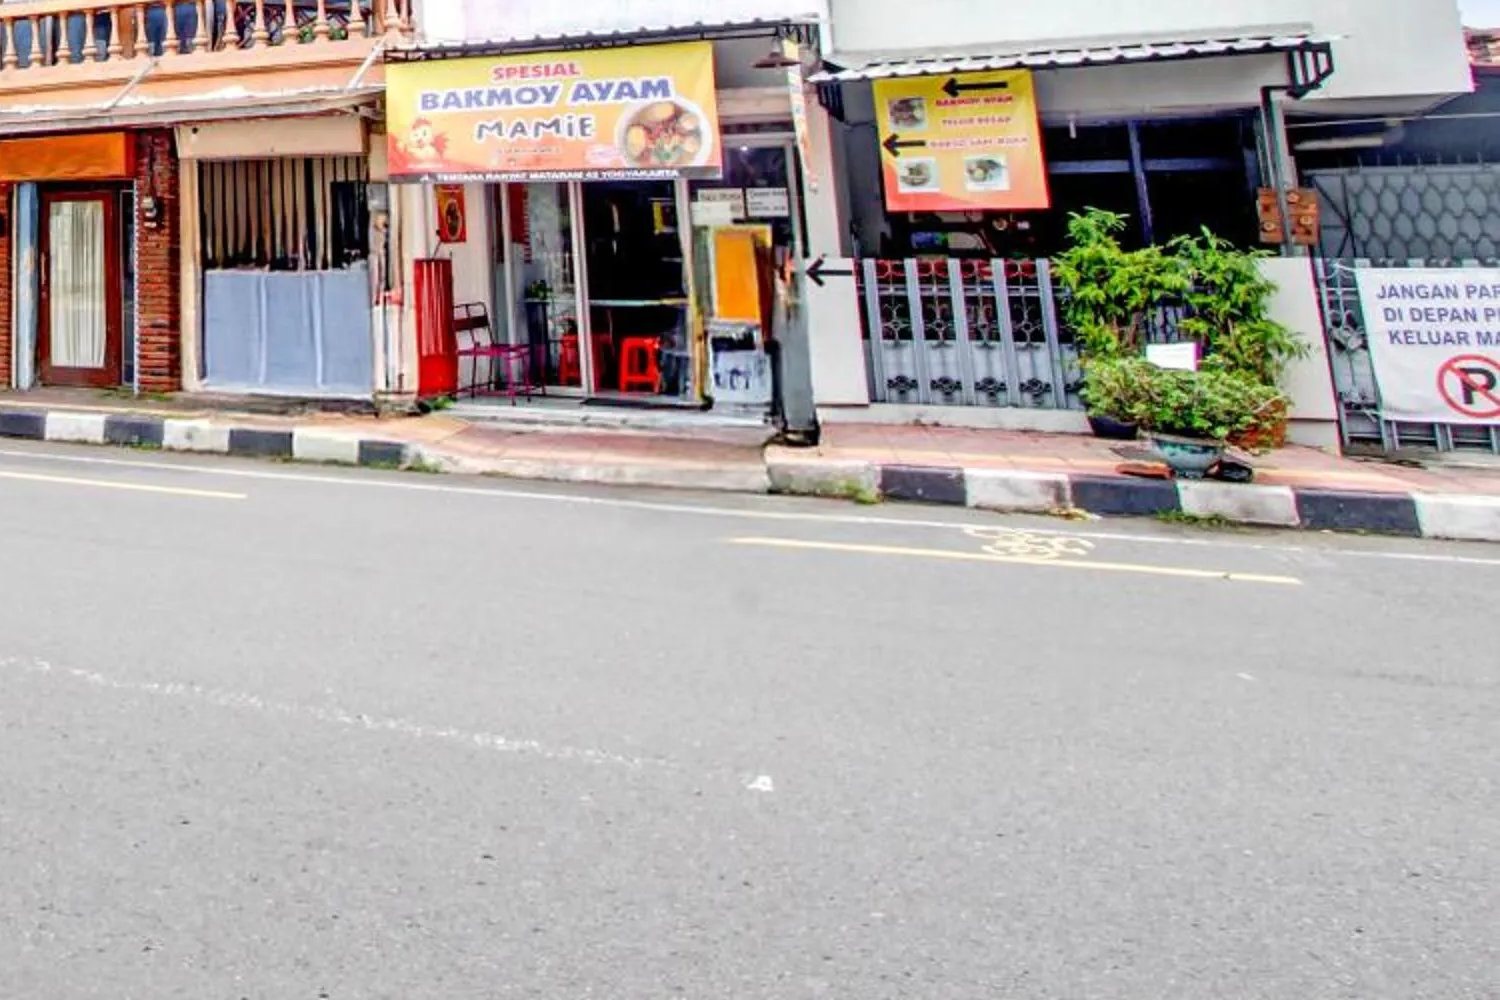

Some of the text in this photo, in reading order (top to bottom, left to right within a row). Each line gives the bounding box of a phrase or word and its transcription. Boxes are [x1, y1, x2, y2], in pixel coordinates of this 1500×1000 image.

[492, 63, 581, 80] SPESIAL
[420, 77, 672, 111] BAKMOY AYAM
[1377, 284, 1460, 300] JANGAN
[1384, 307, 1404, 323] DI
[1410, 307, 1478, 323] DEPAN
[1388, 329, 1469, 346] KELUAR
